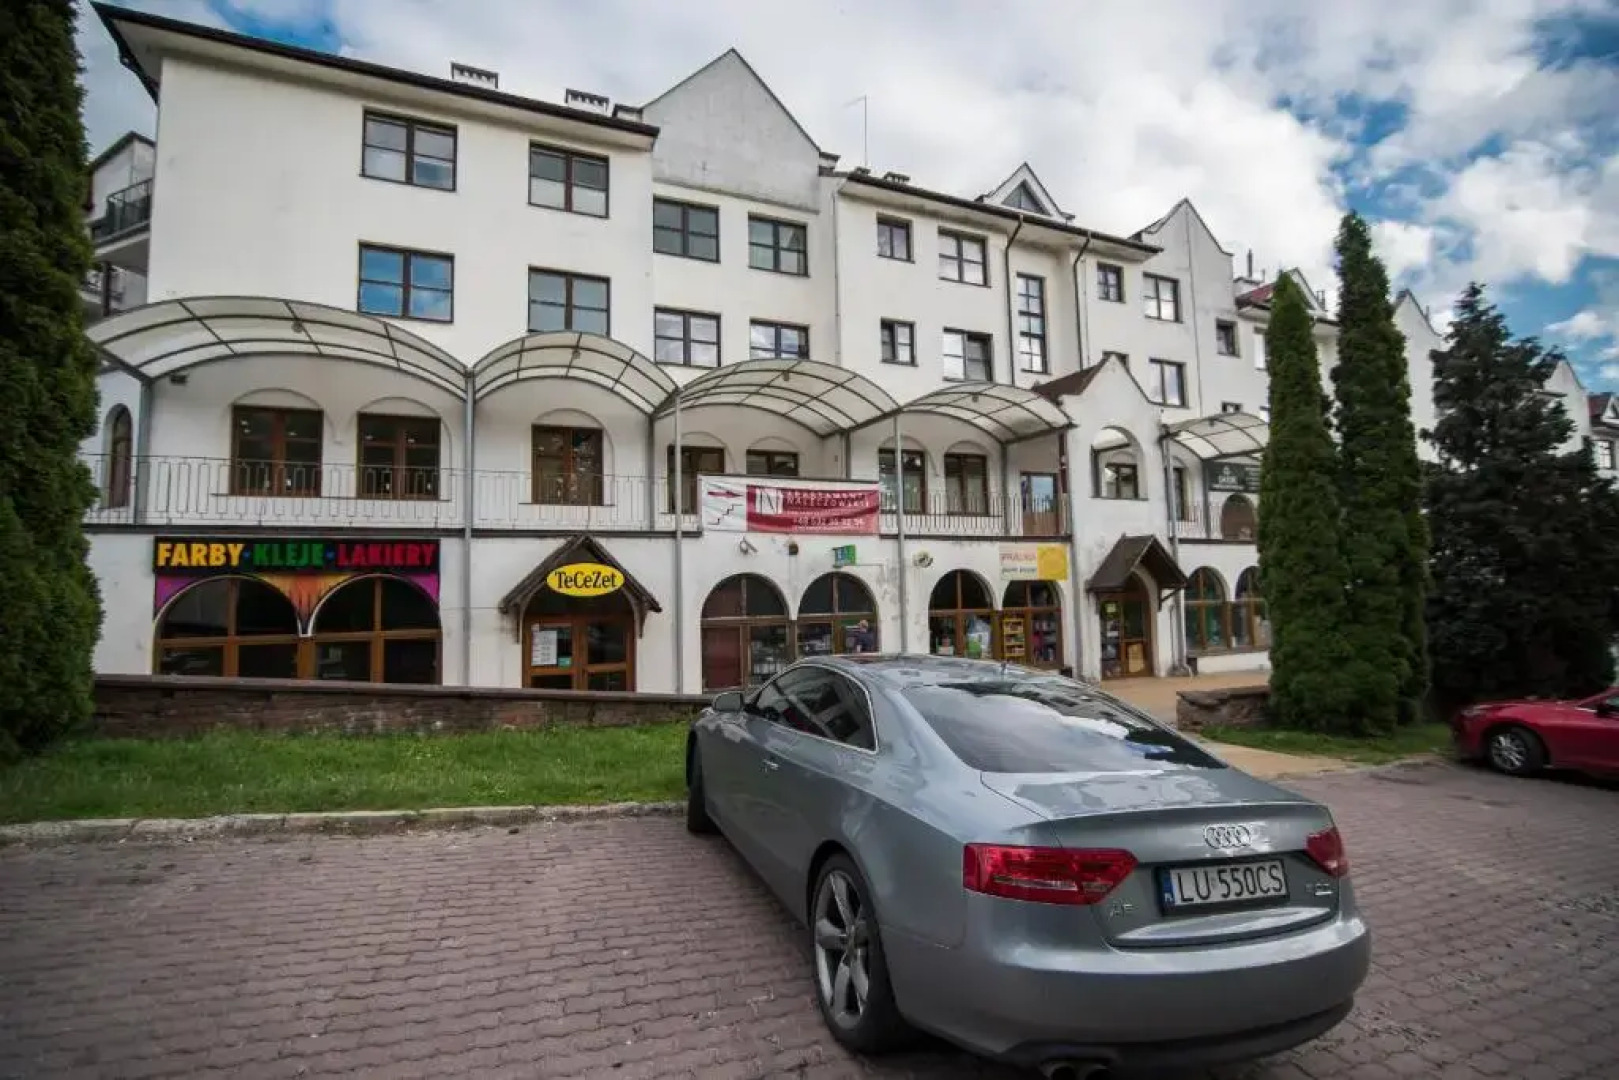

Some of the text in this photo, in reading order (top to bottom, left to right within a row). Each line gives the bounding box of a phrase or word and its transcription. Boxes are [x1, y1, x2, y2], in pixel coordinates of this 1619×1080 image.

[157, 543, 435, 568] FARBY KLEJE LAKIERY
[554, 570, 618, 589] TeCeZet
[1177, 870, 1212, 902] LU
[1216, 864, 1283, 899] 550CS
